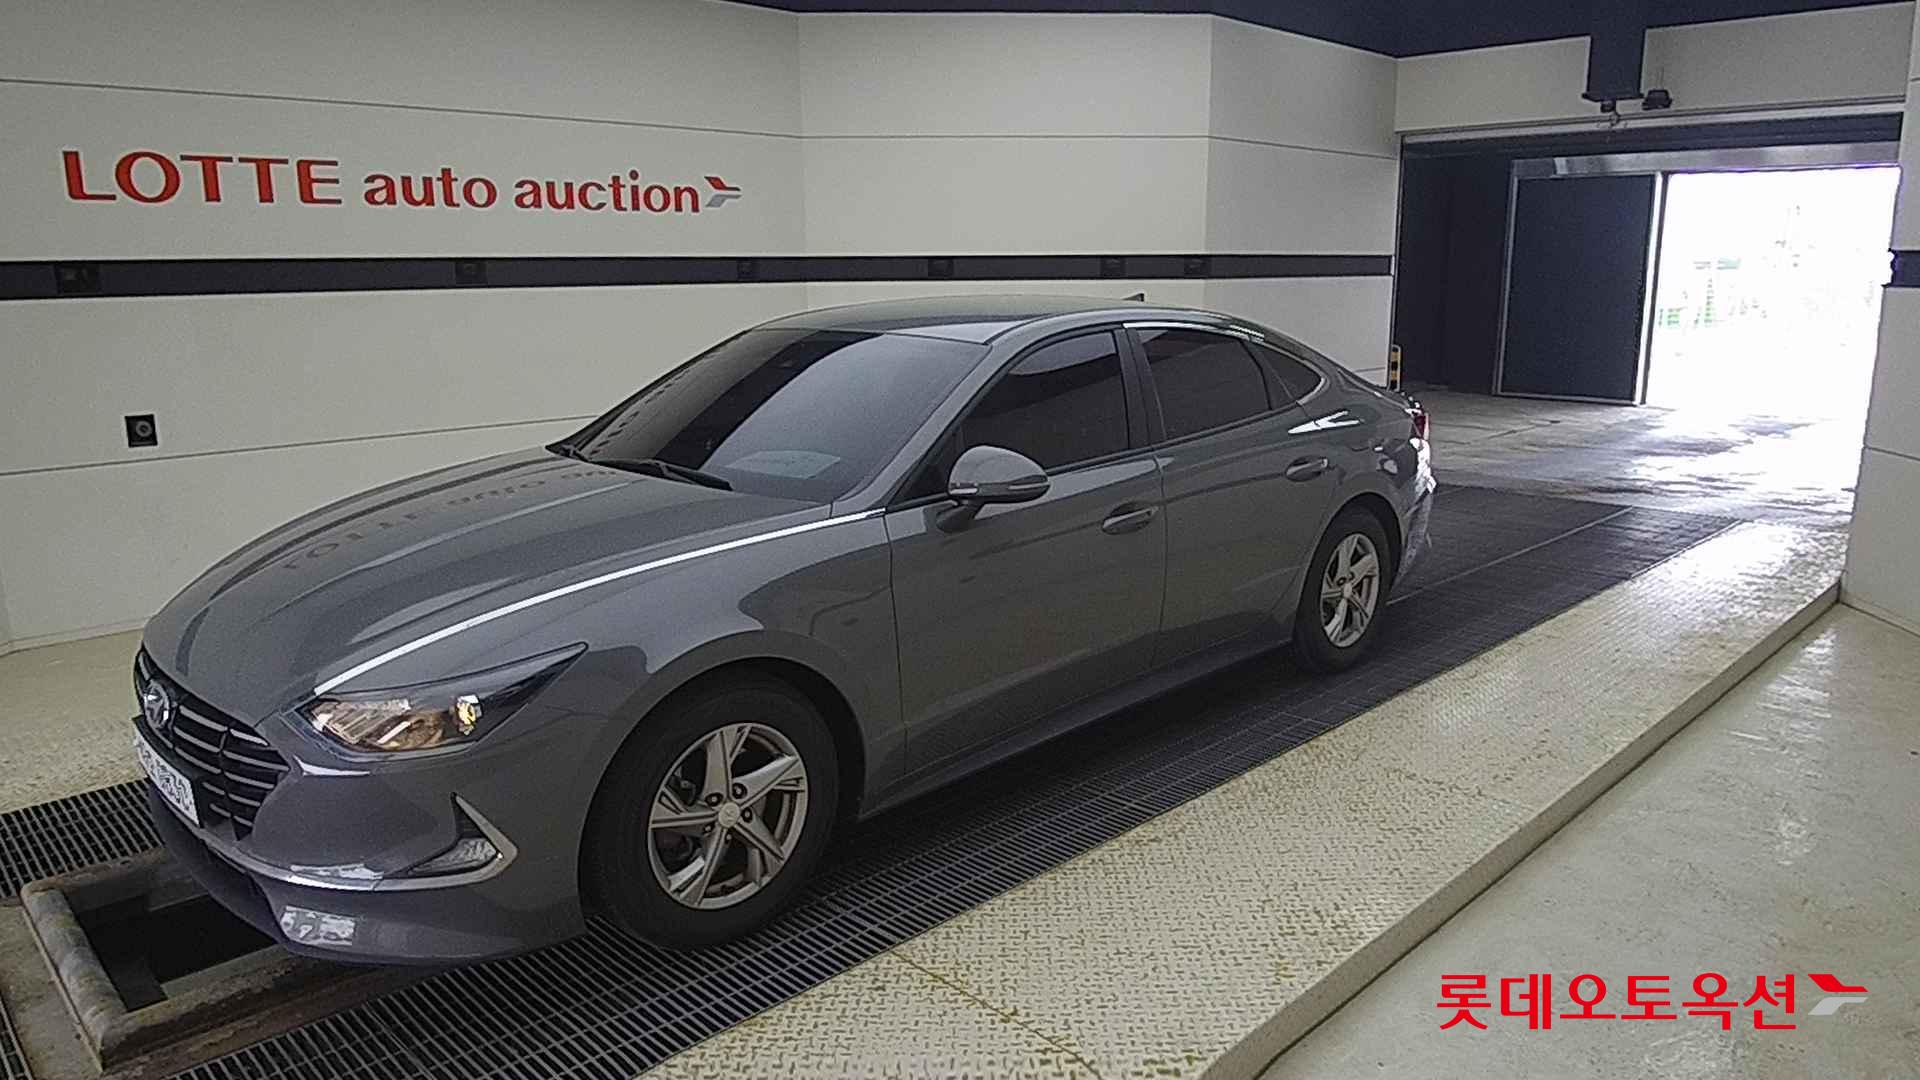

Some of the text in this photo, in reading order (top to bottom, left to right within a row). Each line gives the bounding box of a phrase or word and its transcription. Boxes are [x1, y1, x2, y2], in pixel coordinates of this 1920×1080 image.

[63, 151, 700, 213] LOTTE auto auction
